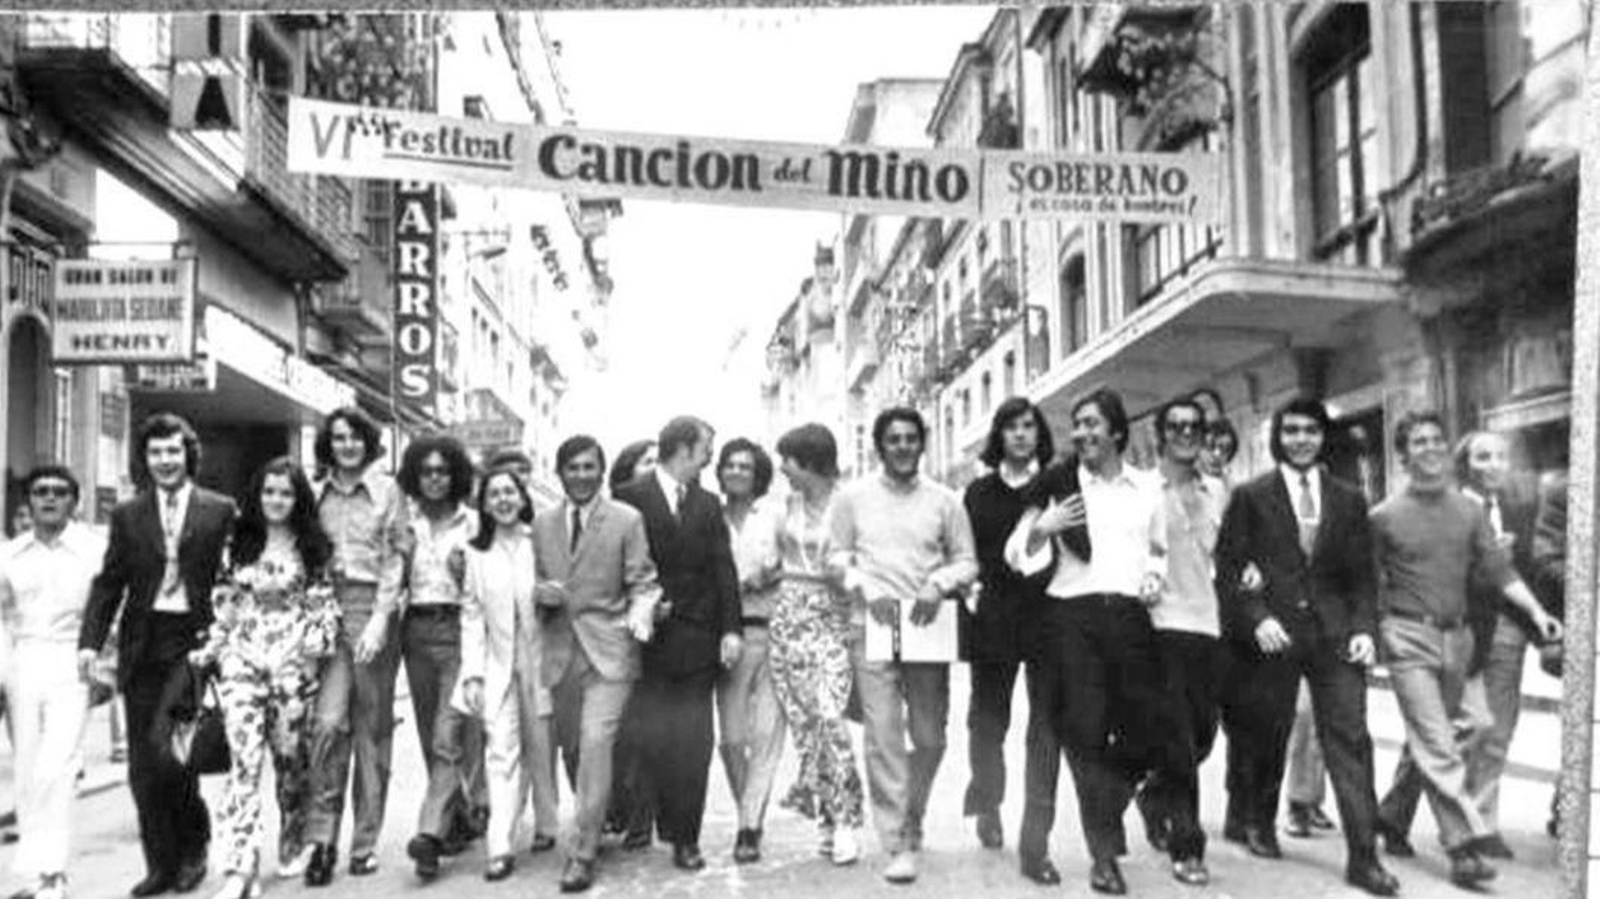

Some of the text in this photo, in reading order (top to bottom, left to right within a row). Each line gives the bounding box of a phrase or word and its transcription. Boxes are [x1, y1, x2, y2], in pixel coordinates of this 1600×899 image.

[538, 134, 763, 191] Cancion
[774, 157, 812, 184] del
[1008, 161, 1188, 196] SOBERANO
[73, 334, 168, 350] HENRY
